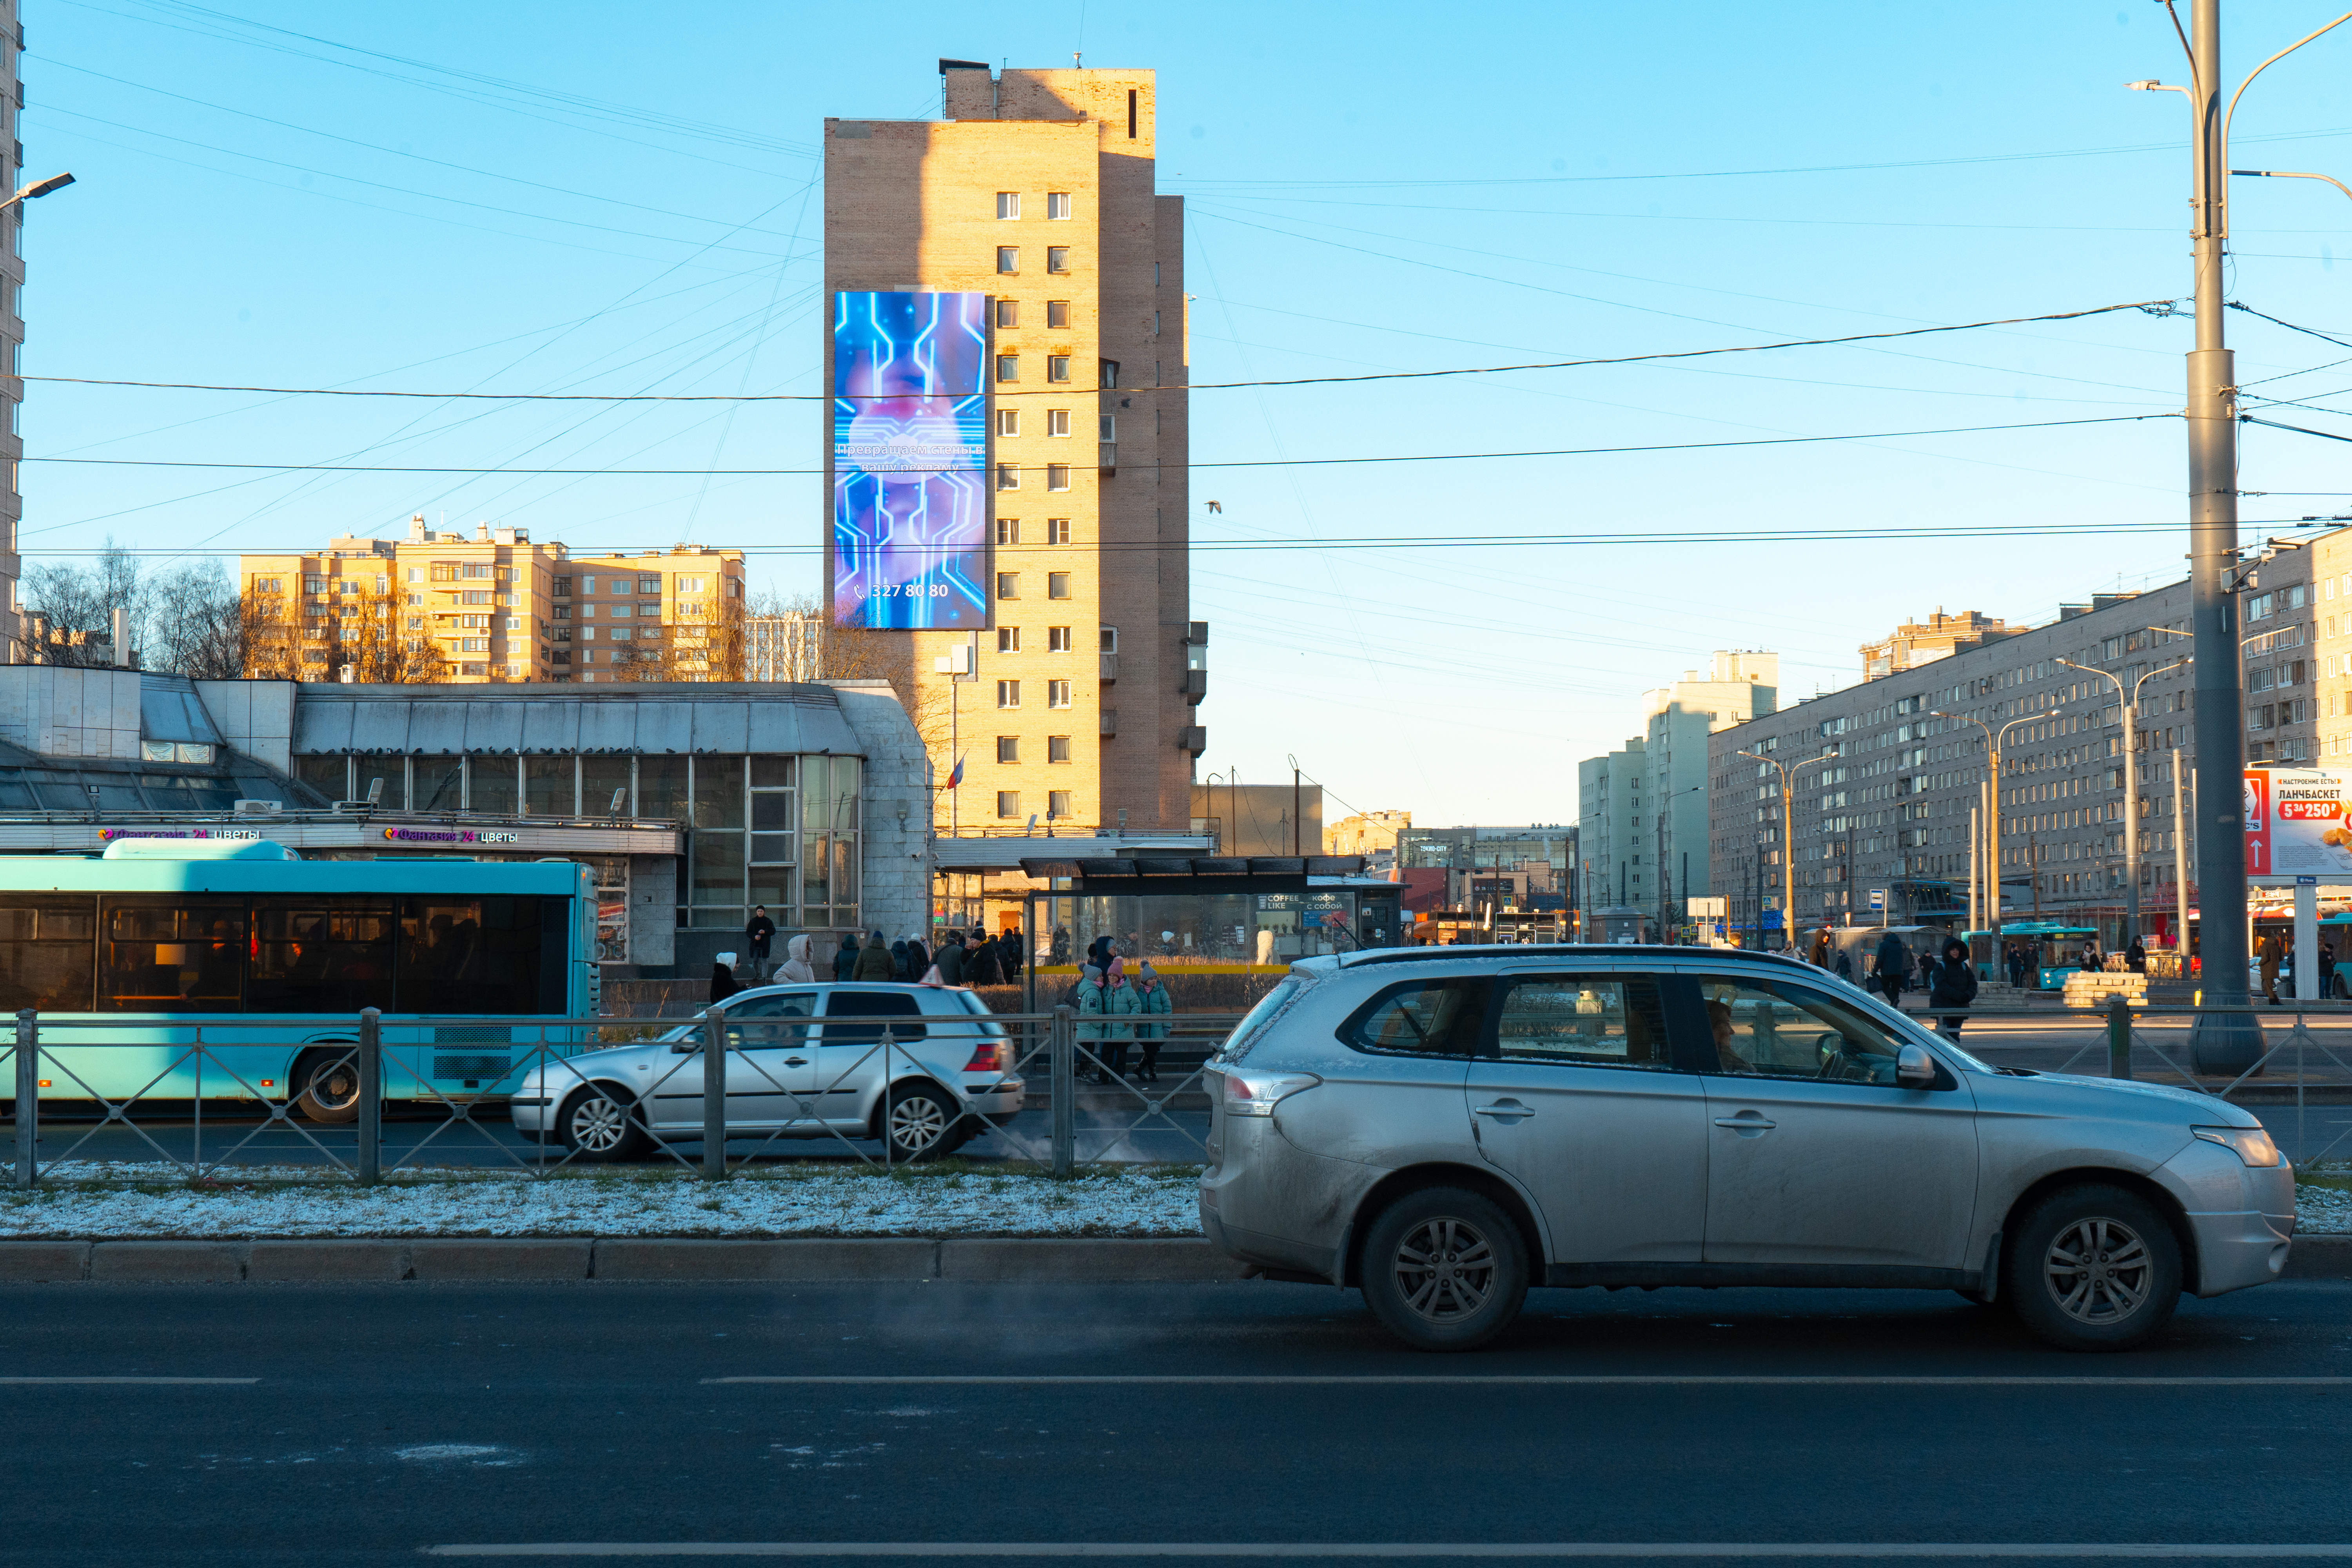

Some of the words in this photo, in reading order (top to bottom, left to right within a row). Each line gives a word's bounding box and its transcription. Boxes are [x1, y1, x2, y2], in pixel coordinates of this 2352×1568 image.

[837, 444, 927, 457] Превращаем
[930, 446, 972, 455] стены
[975, 446, 983, 455] в
[861, 463, 899, 475] вашу
[900, 463, 959, 475] рекламу
[872, 584, 901, 597] 327
[905, 584, 925, 597] 80
[928, 584, 949, 597] 80
[2278, 789, 2341, 799] ЛАНЧБАСКЕТ
[2284, 804, 2293, 817] 5
[2294, 804, 2304, 812] ЗА
[116, 829, 185, 838] Фантазия
[192, 829, 207, 838] 24
[214, 830, 260, 839] цветы
[400, 828, 457, 841] Фантазия
[463, 831, 475, 842] 24
[481, 832, 518, 844] цветы
[1312, 894, 1335, 902] кофе
